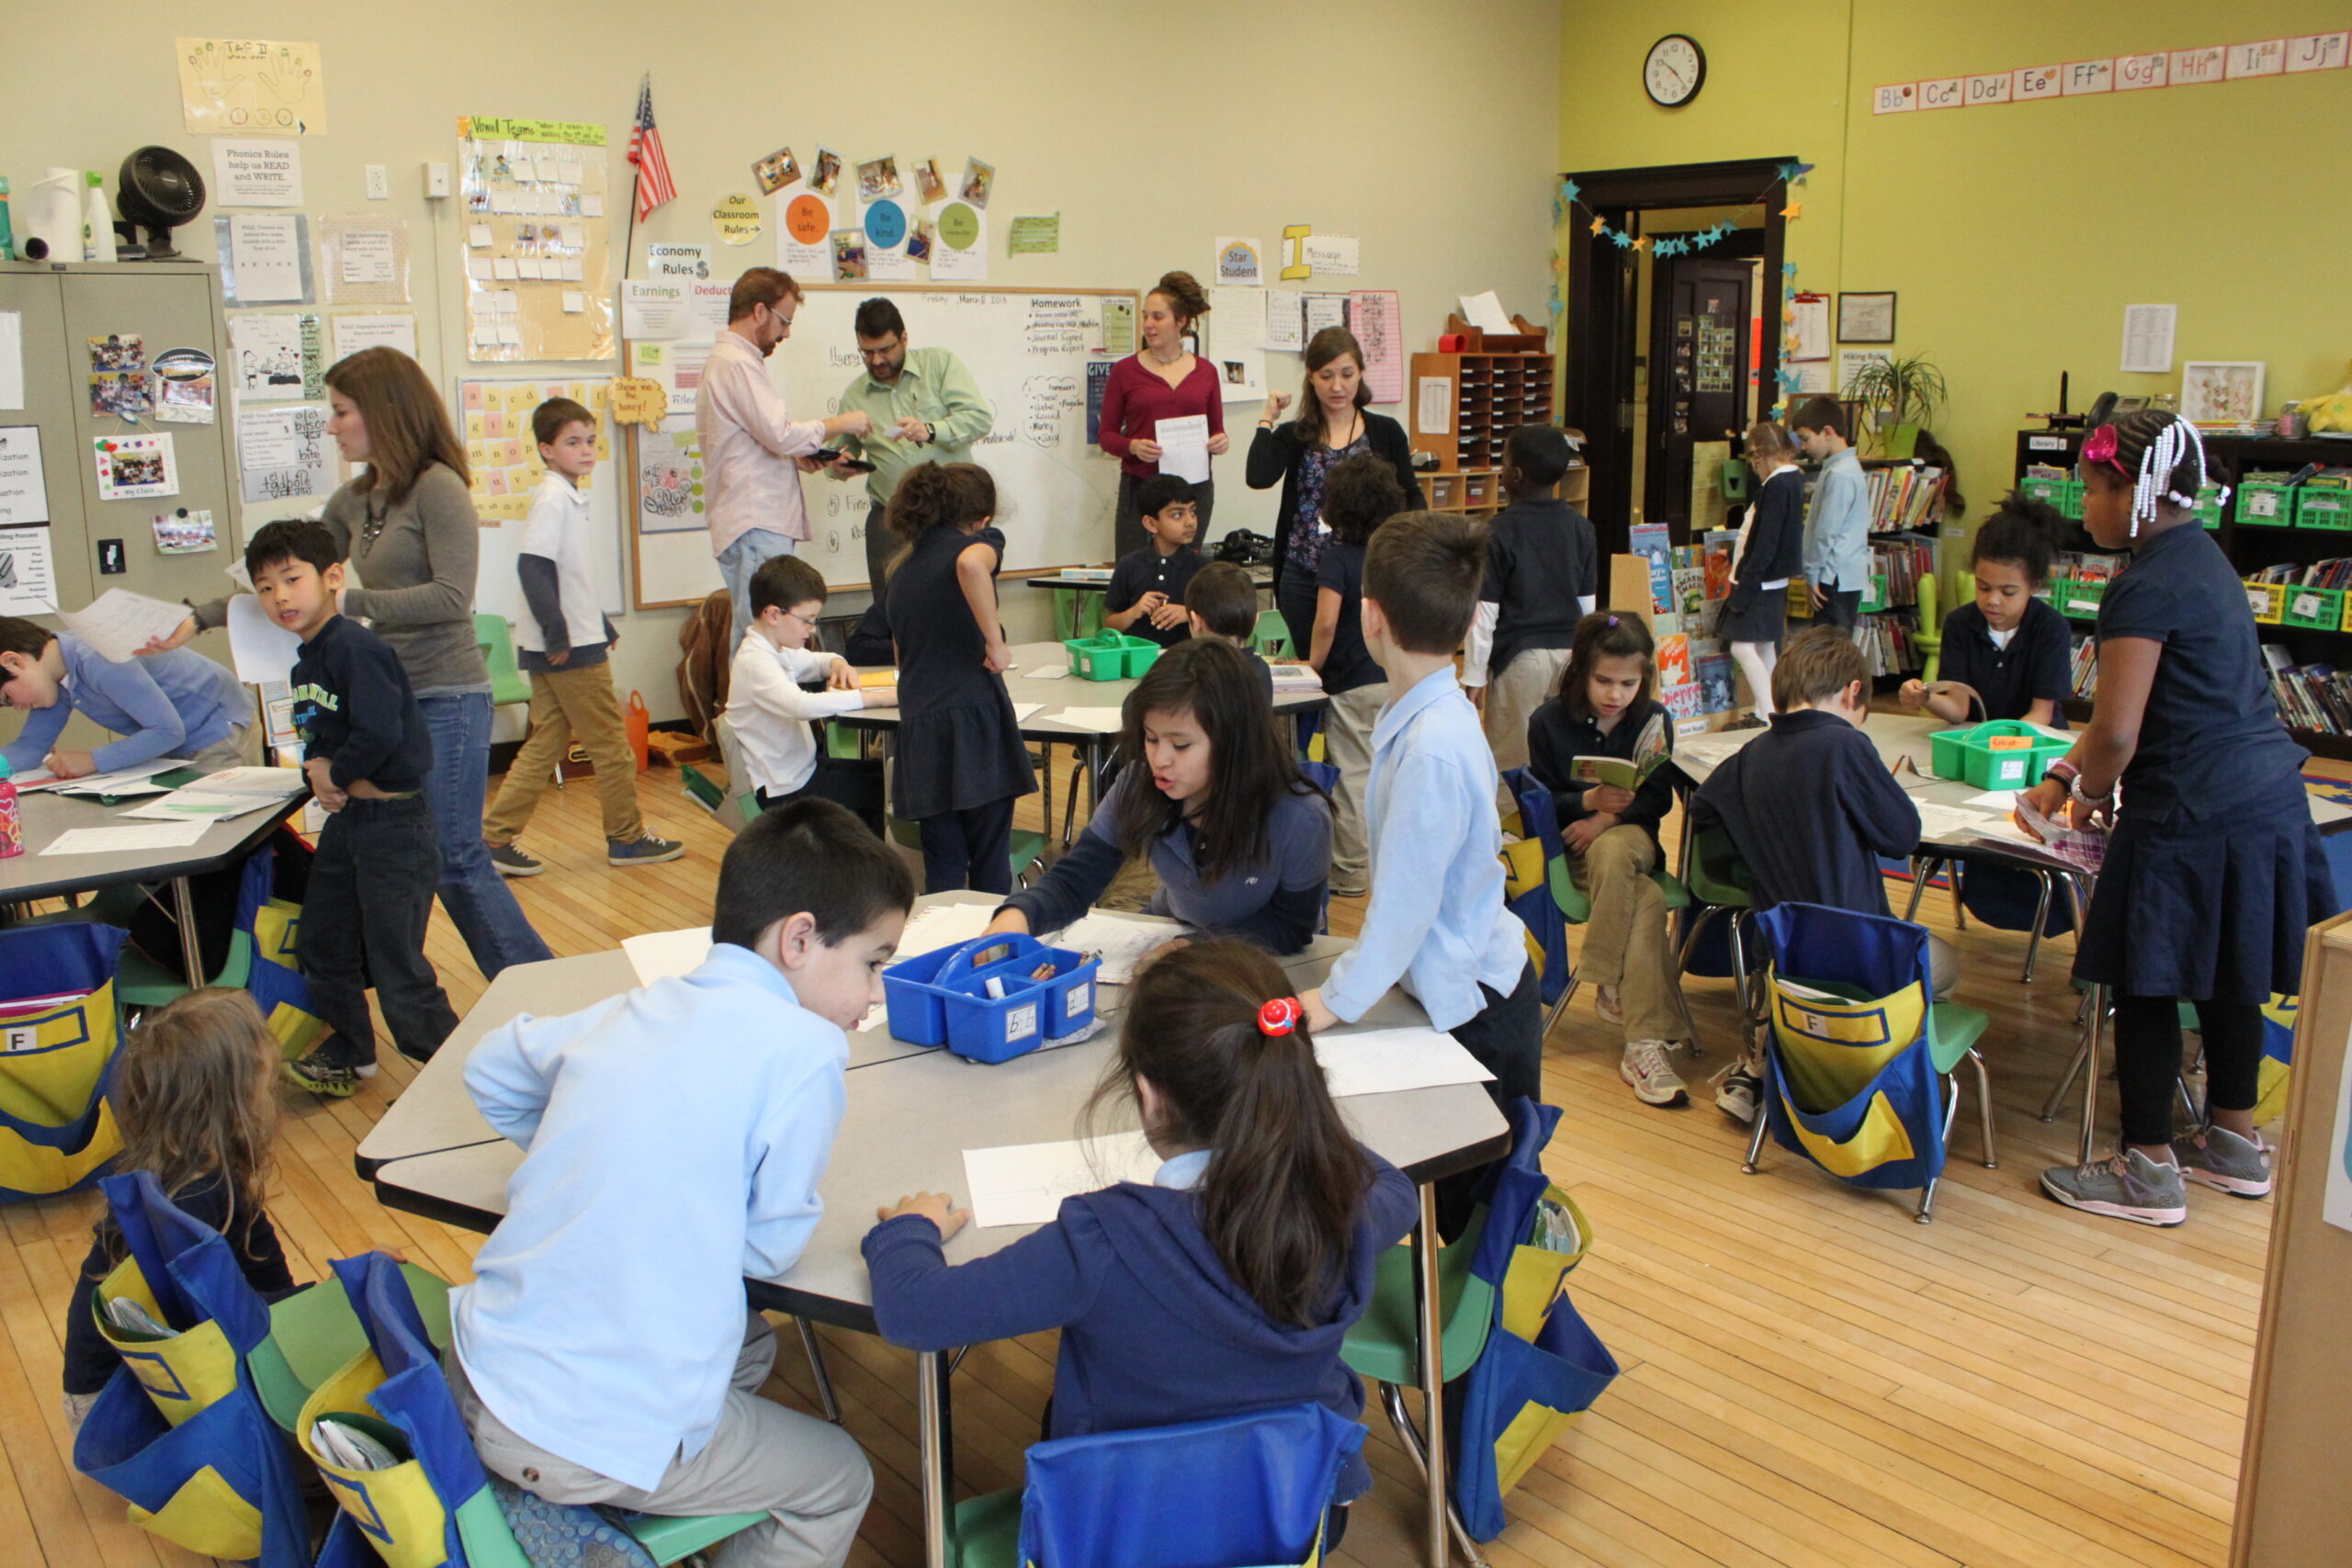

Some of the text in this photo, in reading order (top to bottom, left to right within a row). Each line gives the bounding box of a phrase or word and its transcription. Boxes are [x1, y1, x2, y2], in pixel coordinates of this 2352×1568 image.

[2302, 38, 2327, 66] Jj
[2246, 49, 2260, 70] Ii
[2124, 59, 2154, 85] Gg
[2181, 56, 2207, 77] Hh
[2023, 71, 2046, 92] Ee
[2074, 64, 2097, 86] Ff
[1927, 85, 1950, 104] Cc
[1973, 79, 1997, 99] Dd
[1881, 90, 1904, 108] Bb
[471, 117, 535, 137] Vowel Teams
[227, 150, 263, 158] Phonics
[229, 161, 249, 171] help
[264, 162, 290, 170] READ
[234, 173, 252, 181] and
[729, 196, 745, 205] Our
[713, 209, 759, 220] Classroom
[801, 207, 813, 217] Be
[880, 213, 891, 222] Be
[724, 224, 749, 234] Rules
[954, 219, 963, 227] Be
[650, 245, 701, 258] Economy
[1228, 251, 1248, 264] Star
[1306, 246, 1341, 265] Message
[662, 264, 694, 275] Rules
[1220, 265, 1258, 278] Student
[632, 286, 680, 299] Earnings
[1032, 299, 1081, 309] Homework
[1031, 333, 1057, 343] Journal
[830, 346, 860, 366] Happy
[1844, 353, 1866, 362] Hiking
[1088, 364, 1111, 377] GIVE
[616, 383, 636, 391] Show
[489, 394, 495, 403] b
[526, 391, 534, 400] d
[574, 389, 580, 398] f
[596, 391, 603, 400] f
[471, 423, 480, 434] g
[507, 420, 514, 429] h
[299, 448, 320, 460] bite
[471, 450, 482, 458] m
[493, 450, 501, 458] n
[526, 444, 533, 454] p
[514, 476, 521, 484] v
[1680, 707, 1690, 717] in
[1010, 1013, 1019, 1033] b
[1806, 1013, 1817, 1031] F
[11, 1032, 26, 1050] F
